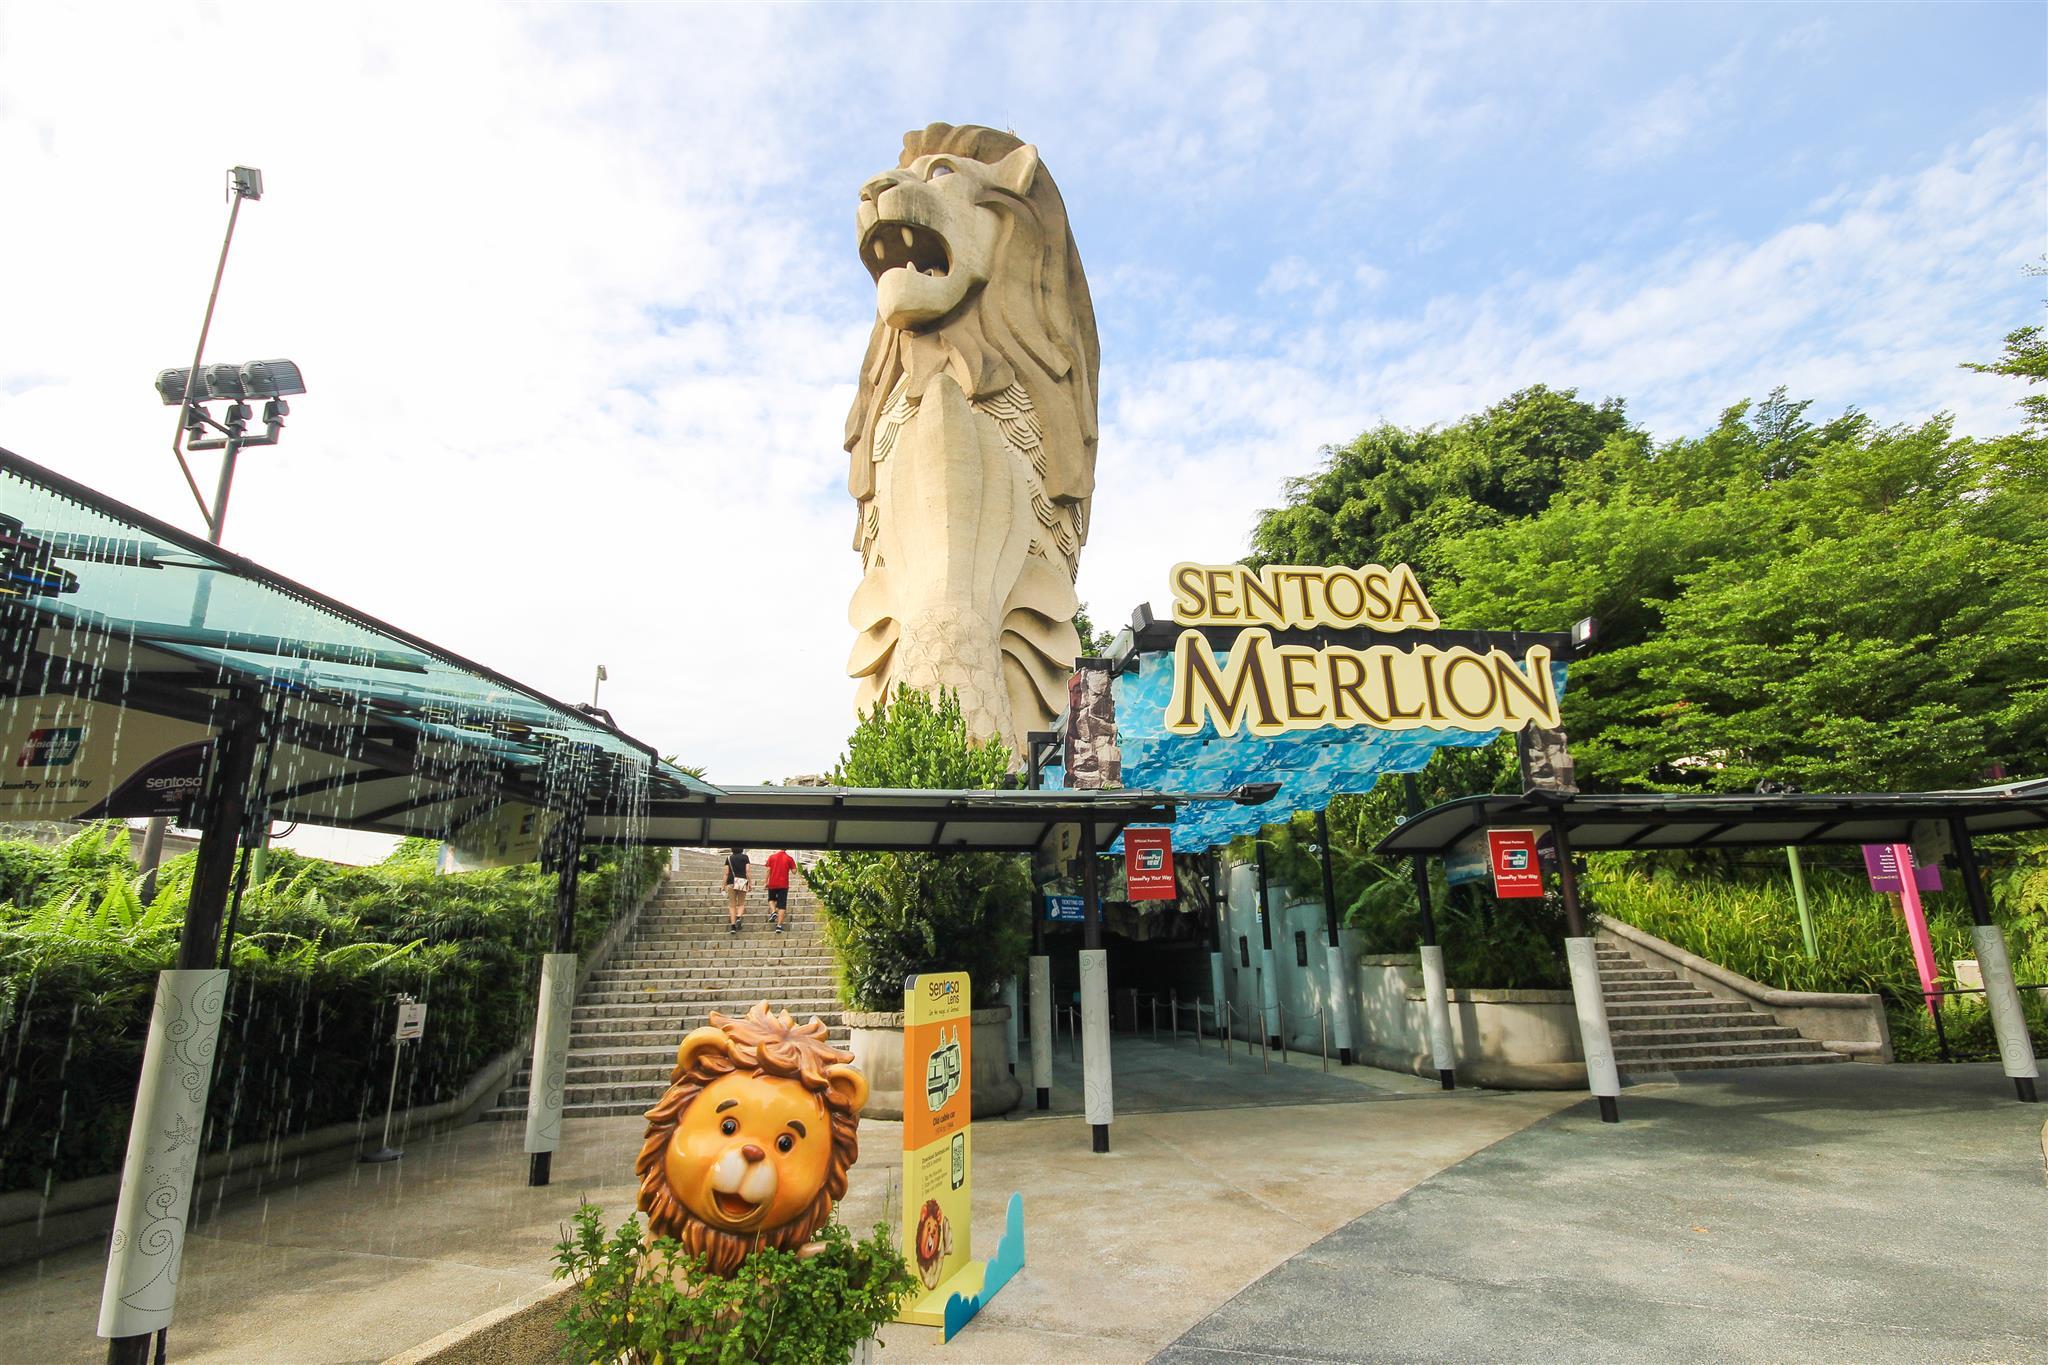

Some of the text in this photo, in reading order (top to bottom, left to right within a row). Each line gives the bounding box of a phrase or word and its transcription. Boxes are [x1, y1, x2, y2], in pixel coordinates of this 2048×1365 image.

[1176, 567, 1435, 622] SENTOSA
[1173, 635, 1554, 728] MERLION
[25, 737, 79, 751] UnionPay
[45, 779, 67, 789] Your
[70, 778, 91, 789] Way
[146, 776, 203, 789] sentosa
[1129, 875, 1150, 883] UnionPay
